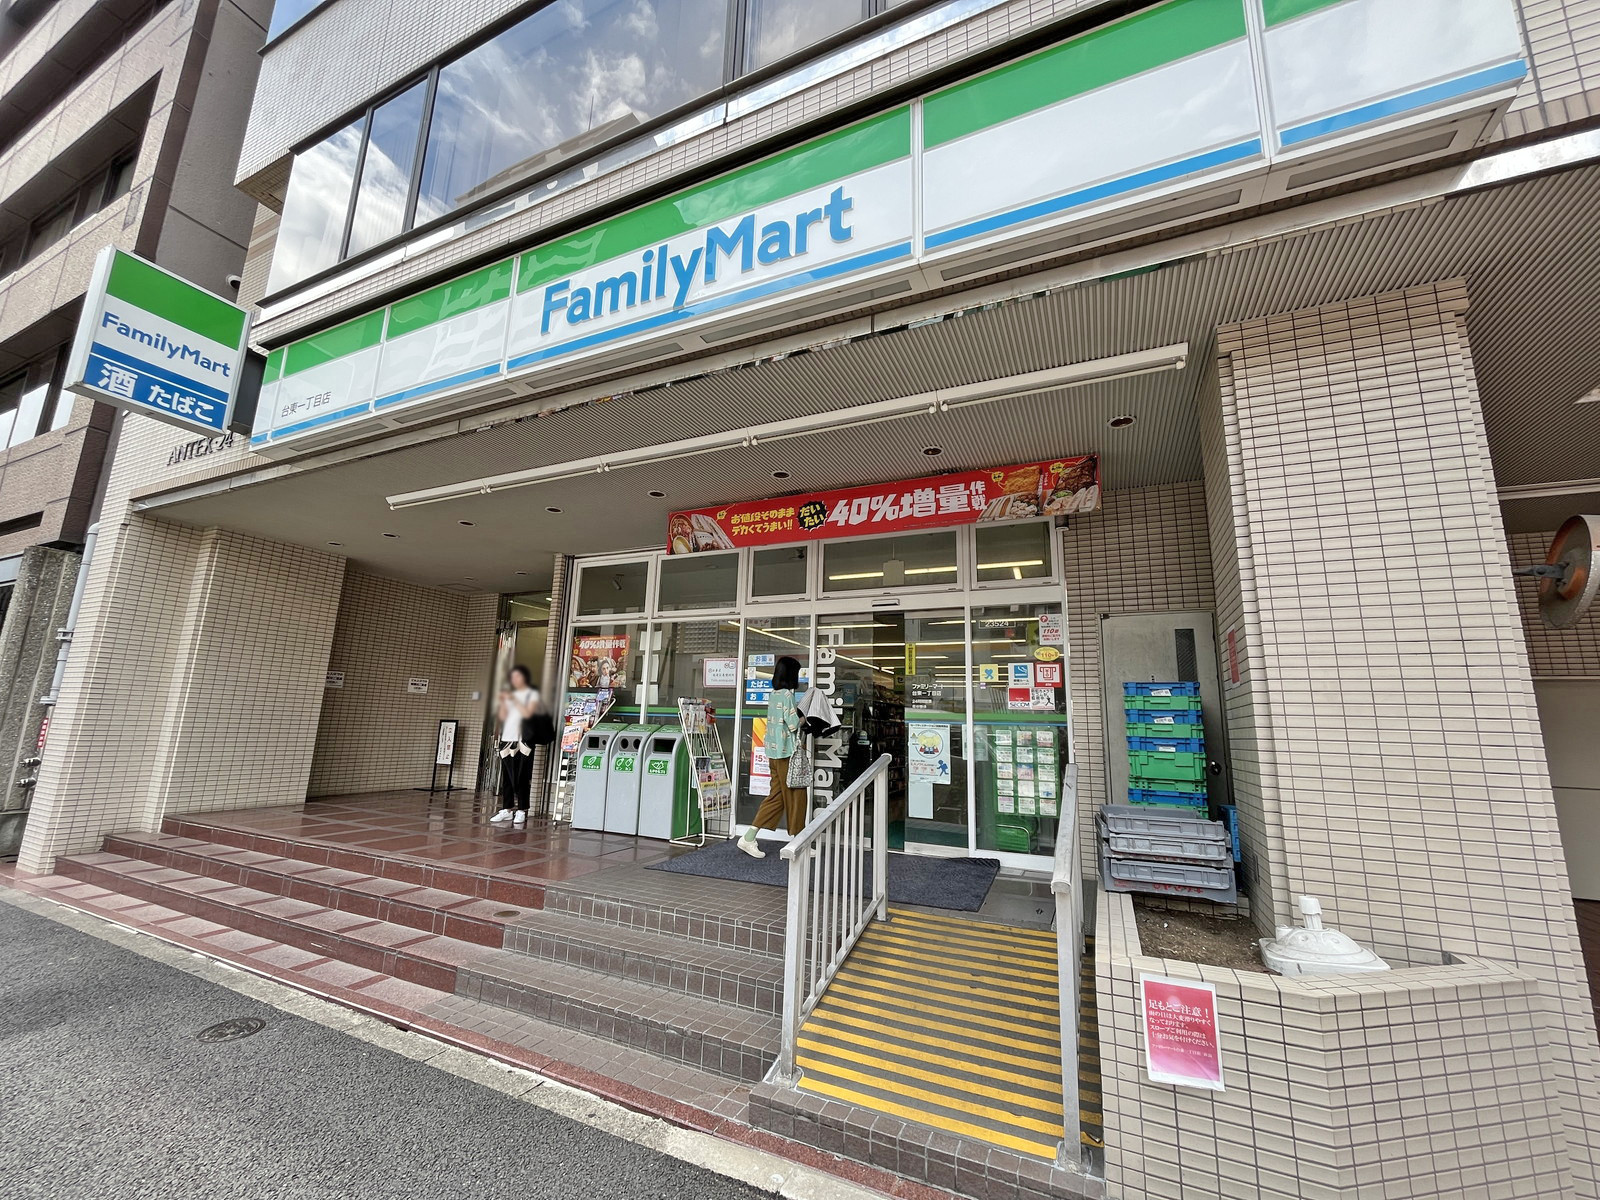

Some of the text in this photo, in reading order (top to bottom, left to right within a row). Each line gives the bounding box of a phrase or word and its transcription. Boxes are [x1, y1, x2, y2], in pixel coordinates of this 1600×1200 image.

[541, 185, 853, 337] FamilyMart
[102, 311, 231, 378] FamilyMart
[98, 363, 214, 423] 酒 たばこ
[281, 391, 331, 418] 台東一丁目店
[731, 507, 795, 524] お値段そのまま
[799, 504, 821, 518] だい
[803, 514, 825, 528] たい
[750, 680, 770, 688] たばこ
[1148, 999, 1209, 1019] 足もとご注意！
